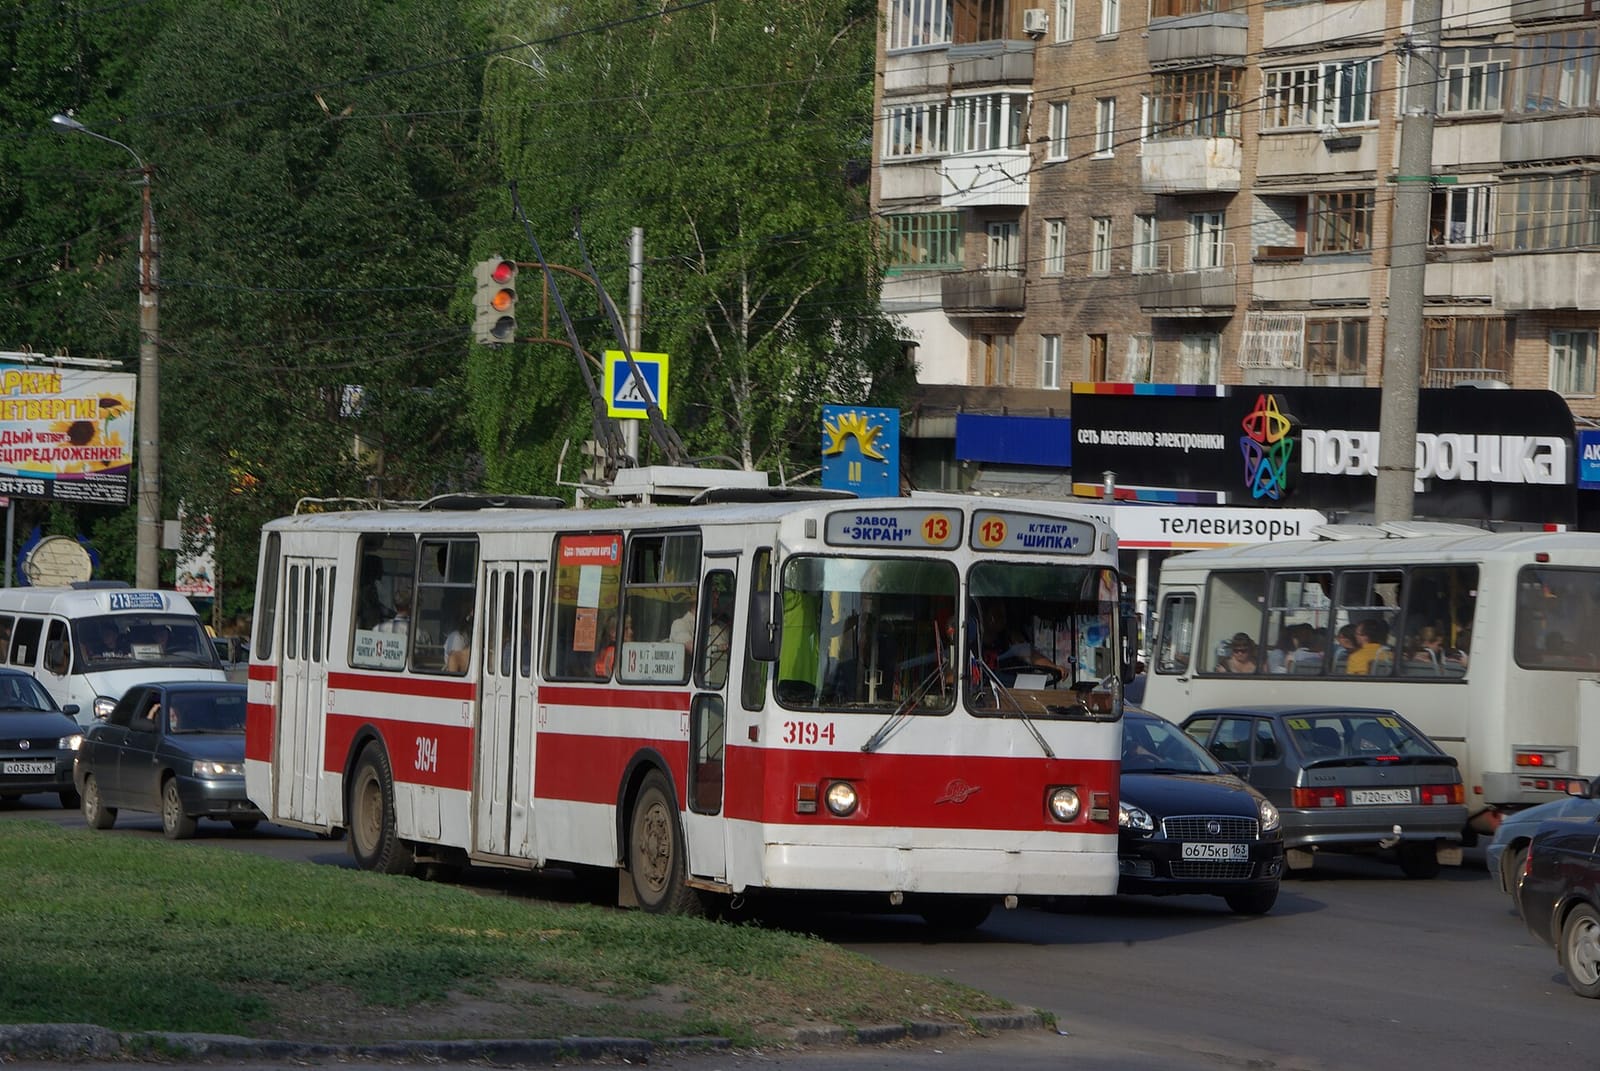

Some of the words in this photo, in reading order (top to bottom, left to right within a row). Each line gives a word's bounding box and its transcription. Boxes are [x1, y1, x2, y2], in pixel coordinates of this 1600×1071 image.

[1077, 429, 1099, 444] сеть
[1100, 430, 1154, 447] магазинов
[1155, 432, 1225, 453] электроники
[855, 516, 898, 528] ЗАВОД
[925, 518, 948, 539] 13
[982, 521, 1004, 542] 13
[1029, 523, 1068, 534] К/ТЕАТР
[1160, 518, 1300, 541] телевизоры
[111, 593, 131, 609] 213
[628, 650, 637, 672] 13
[783, 721, 836, 745] 3194
[415, 736, 438, 773] 3194
[1231, 845, 1246, 855] 163
